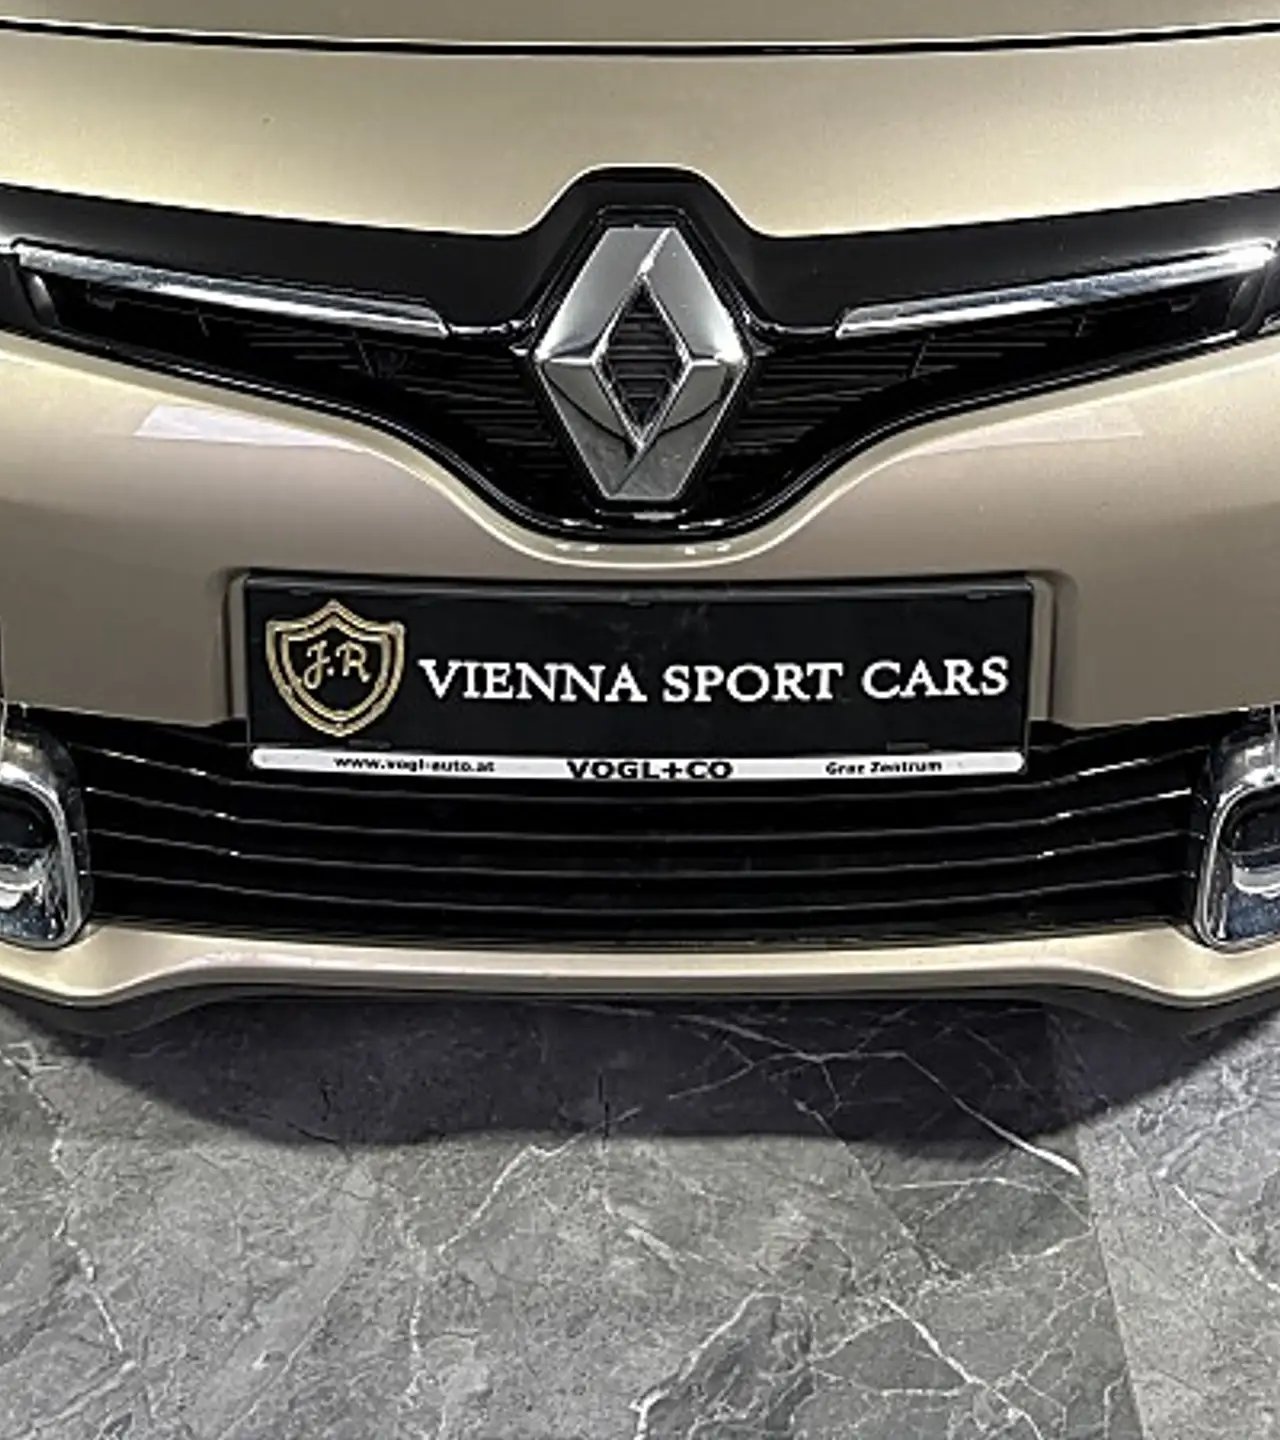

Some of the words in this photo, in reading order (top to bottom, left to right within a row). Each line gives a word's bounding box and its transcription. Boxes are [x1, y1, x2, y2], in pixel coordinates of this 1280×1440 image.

[420, 659, 647, 703] VIENNA
[662, 662, 843, 702] SPORT
[861, 657, 1009, 698] CARS
[567, 760, 734, 779] VOGL+CO
[825, 761, 865, 776] Graz
[870, 760, 942, 774] Zentrum
